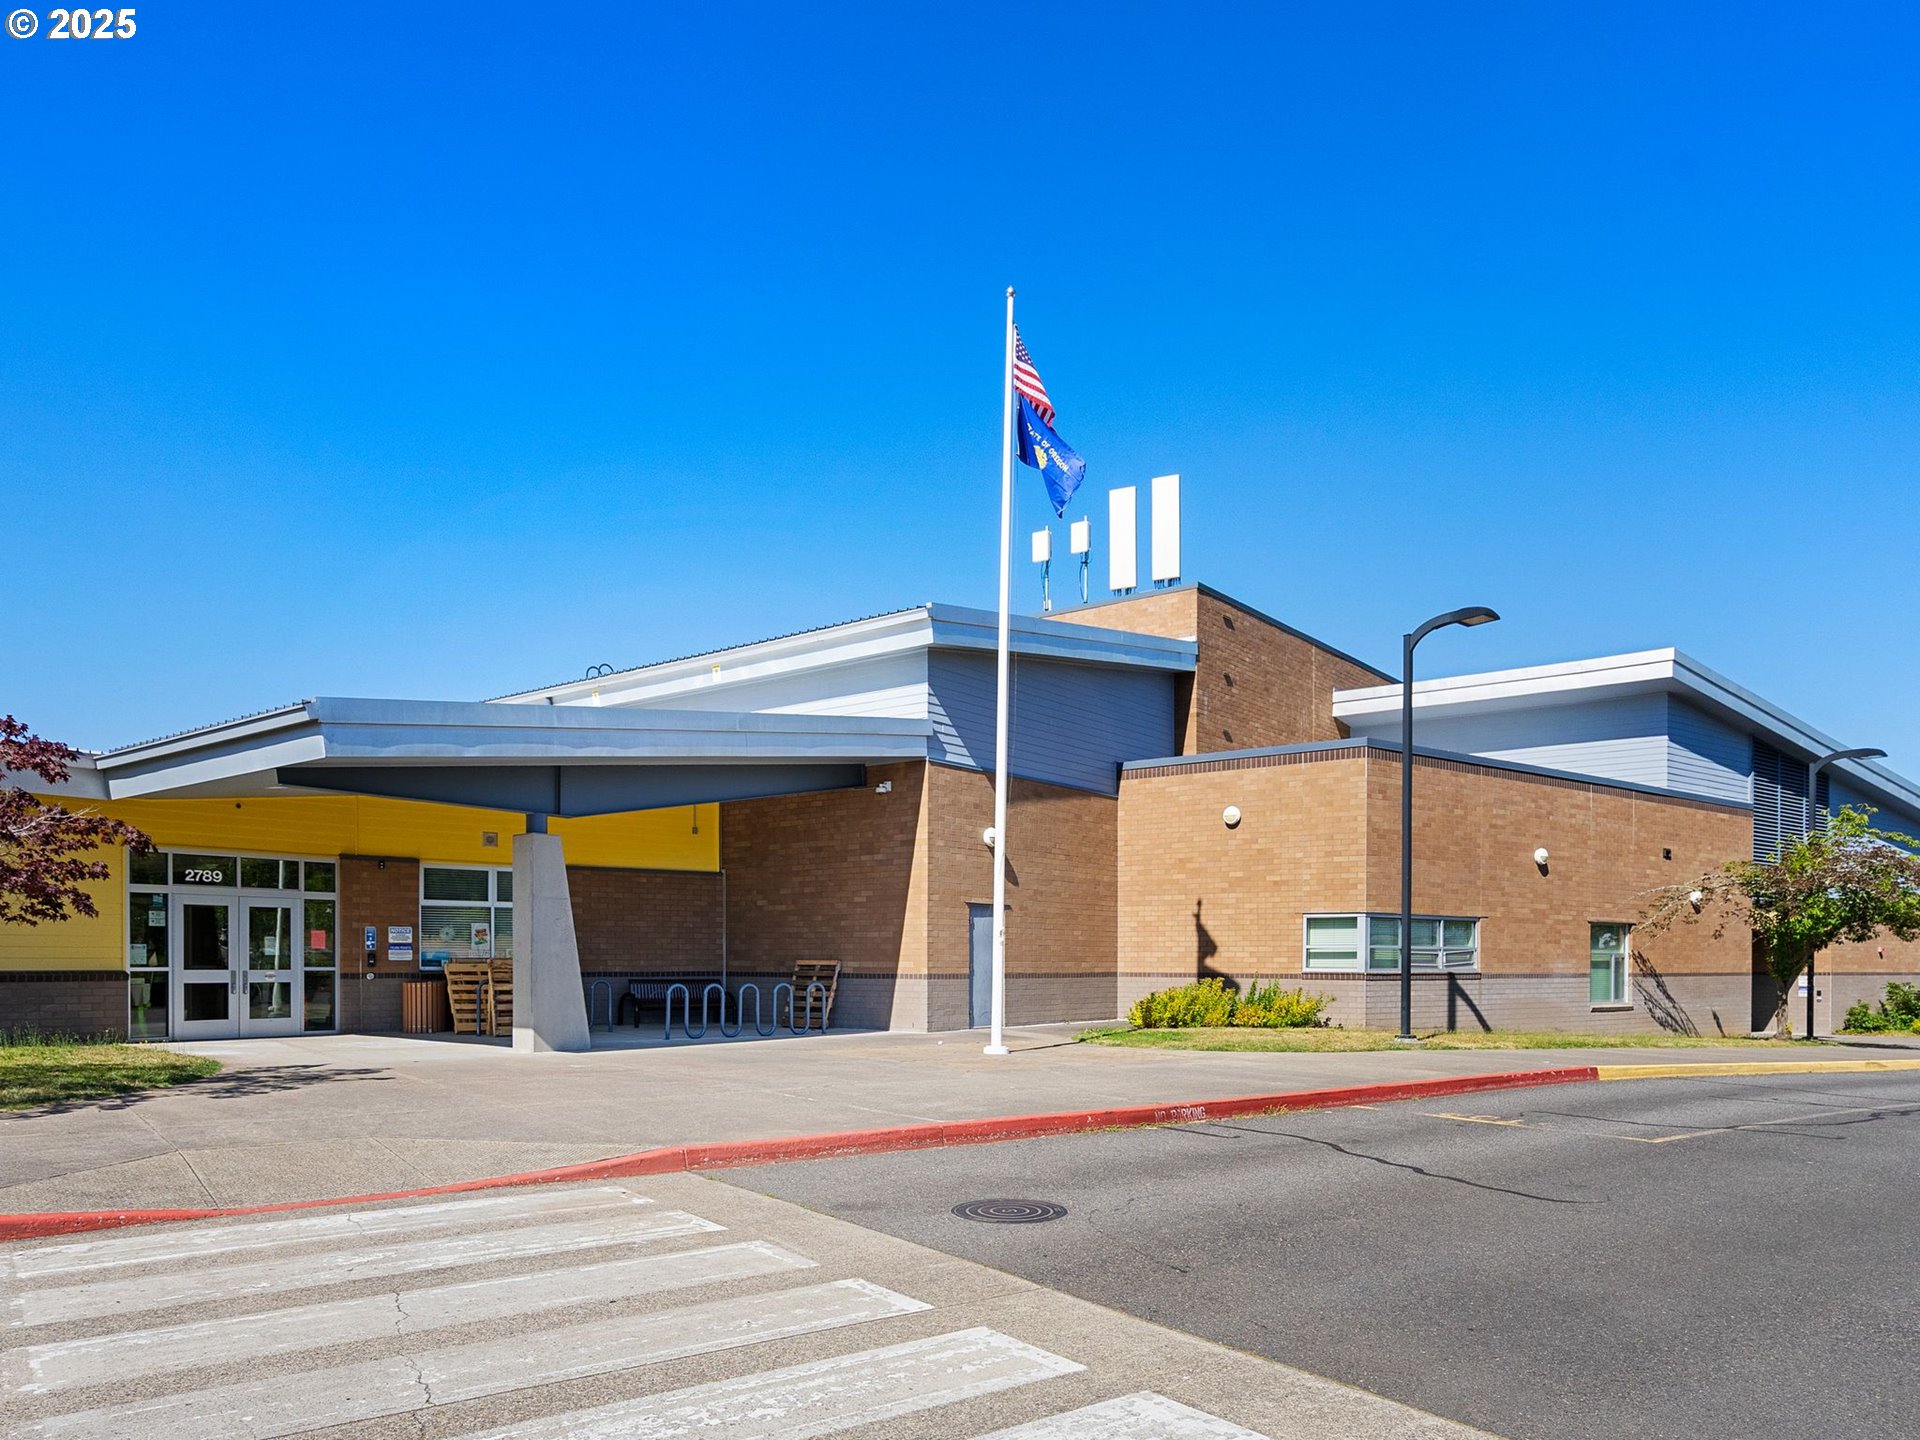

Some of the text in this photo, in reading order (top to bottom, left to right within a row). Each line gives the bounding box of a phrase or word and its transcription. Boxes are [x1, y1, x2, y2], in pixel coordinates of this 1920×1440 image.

[1041, 440, 1051, 449] OF
[1049, 448, 1069, 472] OREGON
[185, 869, 222, 882] 2789
